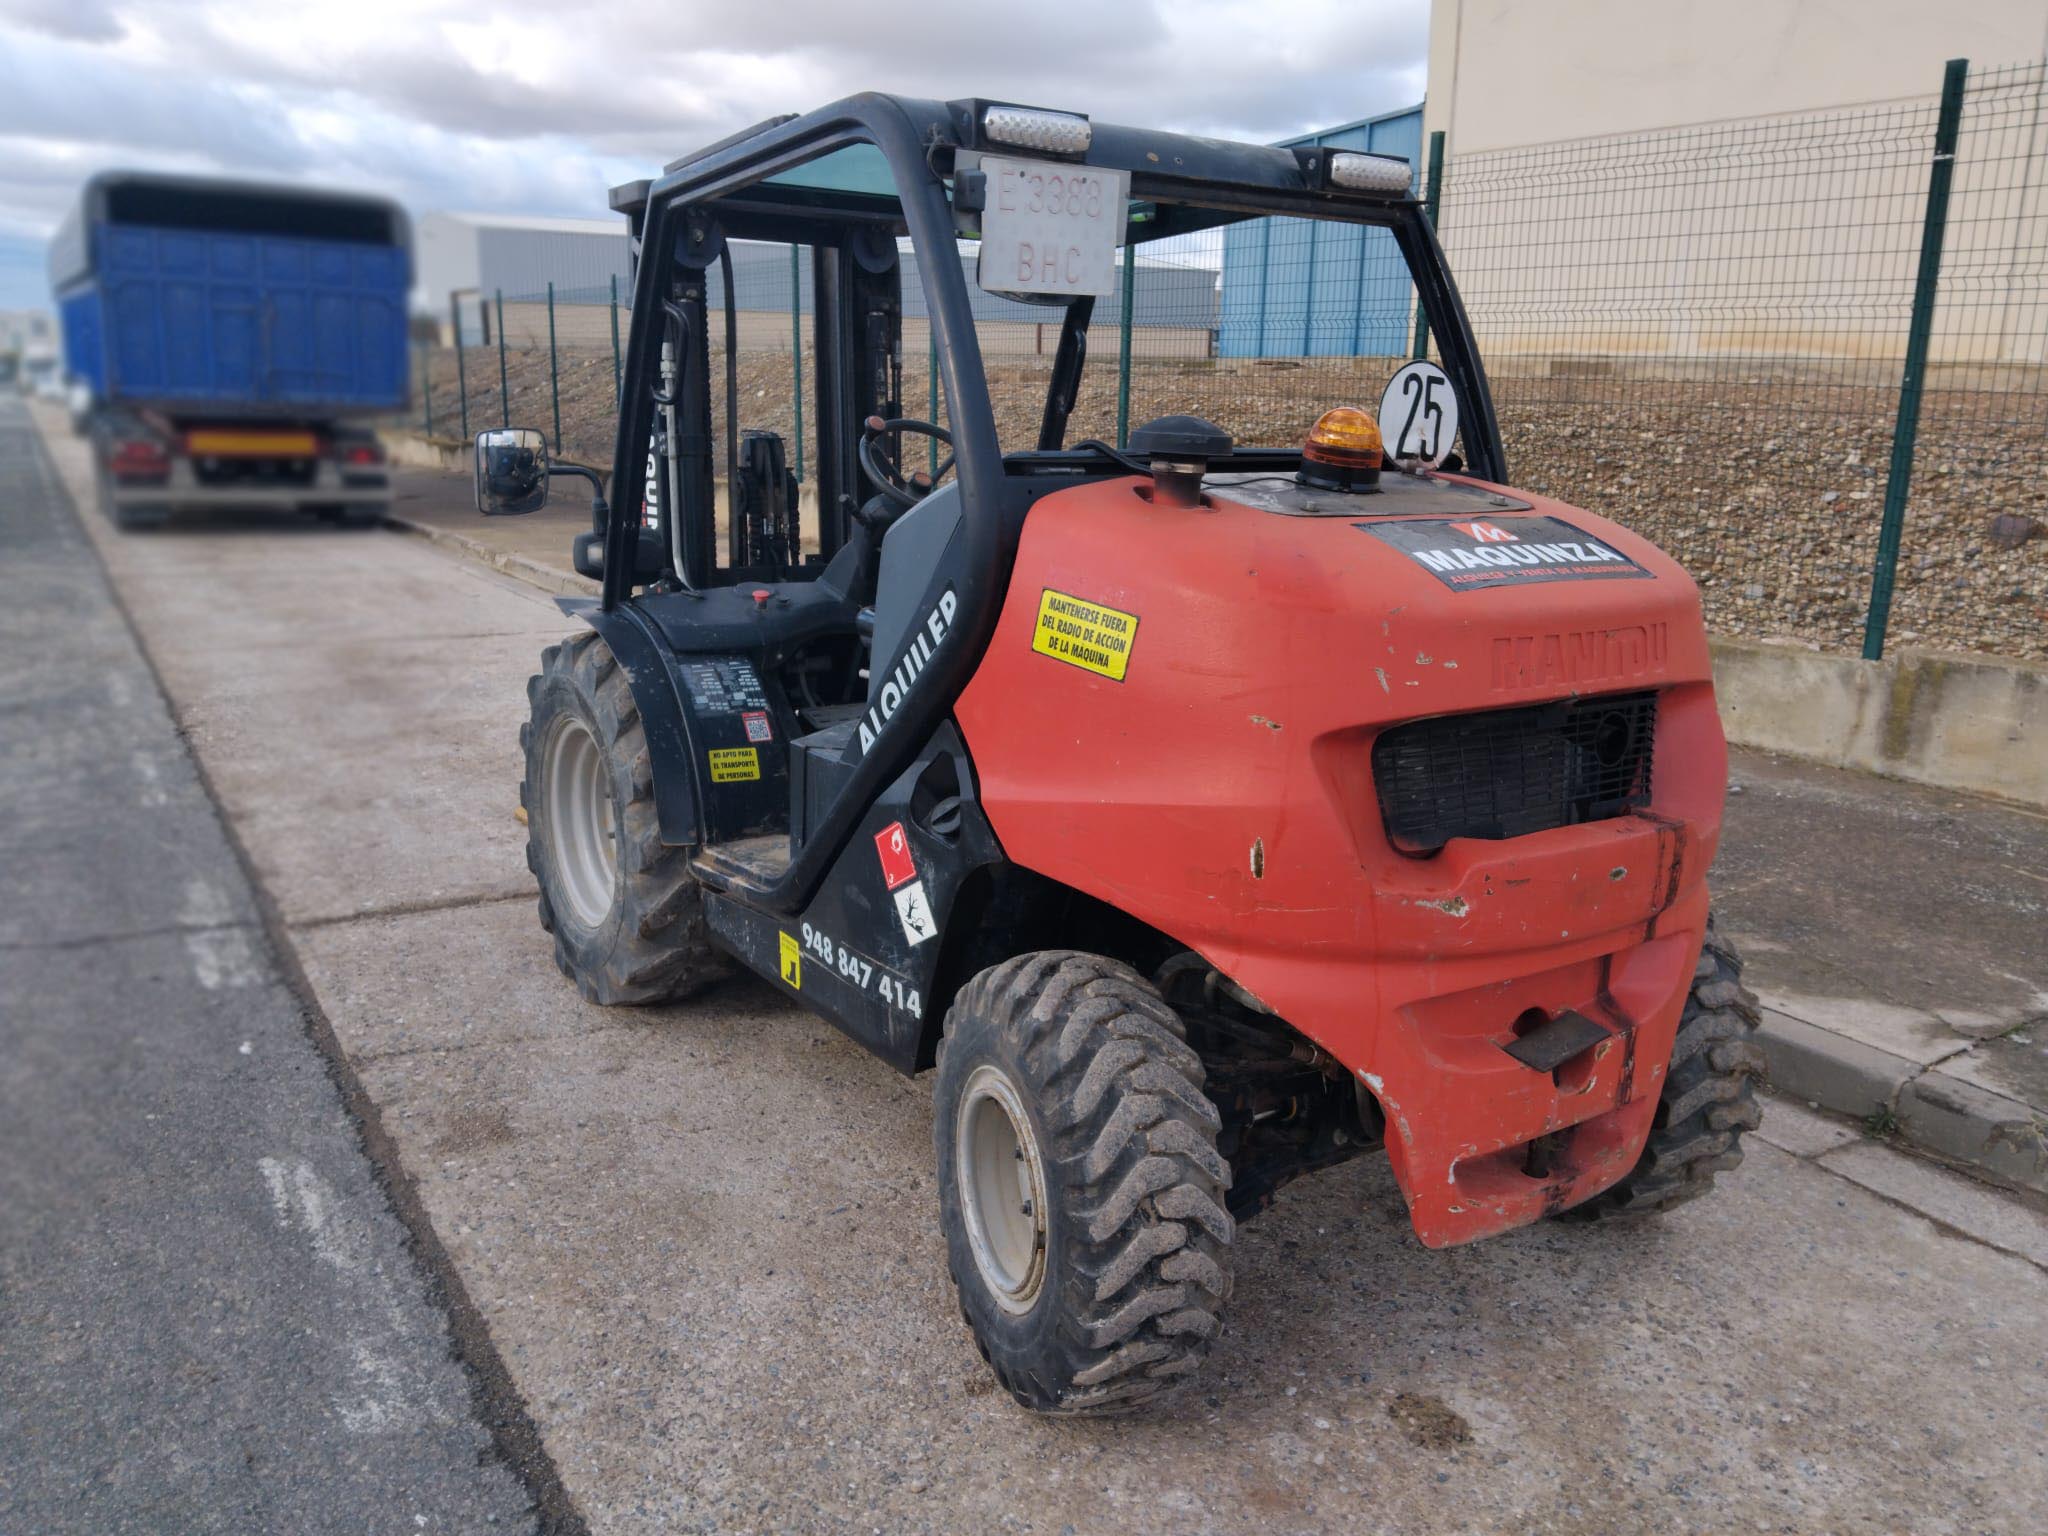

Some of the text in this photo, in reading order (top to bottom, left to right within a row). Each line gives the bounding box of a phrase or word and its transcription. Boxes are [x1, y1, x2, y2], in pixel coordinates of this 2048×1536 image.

[998, 169, 1102, 218] E 3388
[1018, 243, 1081, 284] BHC
[1395, 372, 1446, 462] 25
[1412, 542, 1624, 571] MAQUINZA
[1042, 614, 1055, 630] DEL
[1056, 619, 1082, 639] RADIO
[1083, 627, 1094, 643] DE
[1048, 597, 1128, 634] MANTENERSE FUERA
[1048, 636, 1058, 650] DE
[1060, 641, 1069, 655] LA
[721, 760, 755, 769] TRANSPORTE
[802, 922, 922, 1020] 948 847 414
